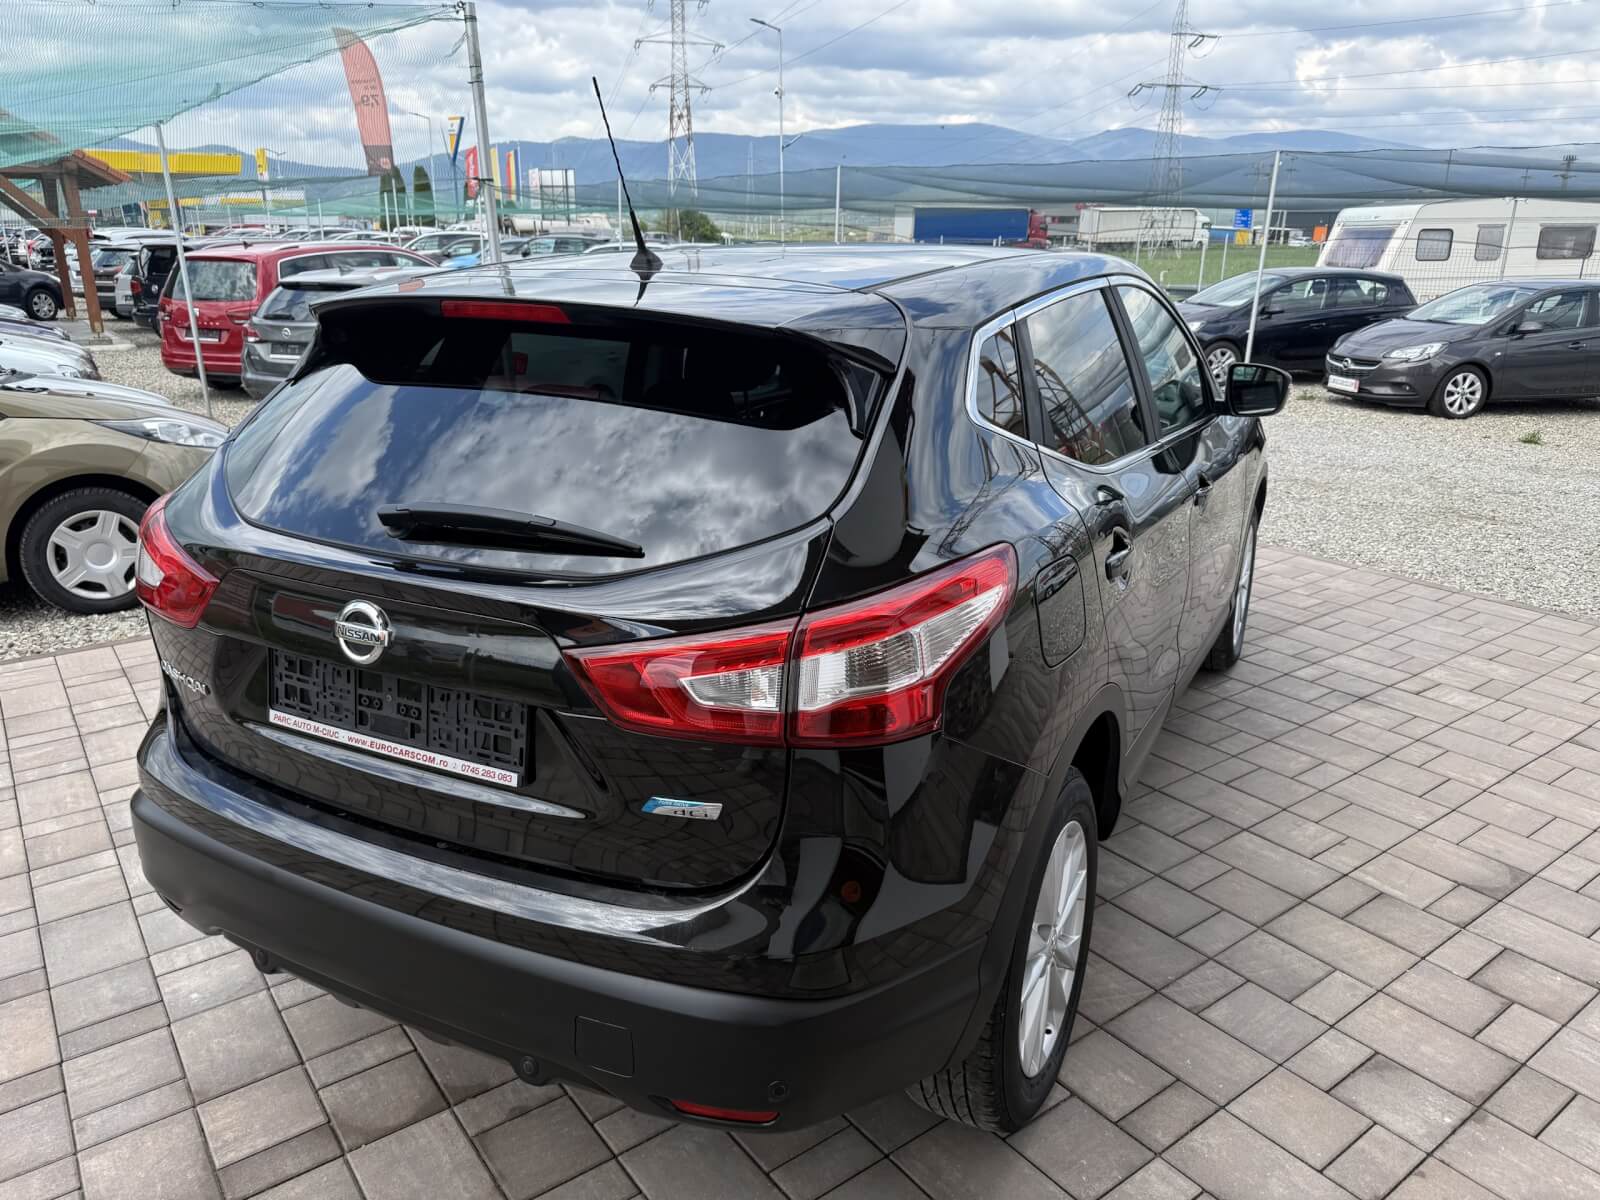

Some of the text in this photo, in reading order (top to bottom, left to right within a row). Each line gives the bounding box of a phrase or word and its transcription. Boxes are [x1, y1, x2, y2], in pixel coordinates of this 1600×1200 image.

[337, 624, 380, 643] NISSAN
[273, 713, 292, 725] PARC
[292, 719, 312, 731] AUTO
[312, 723, 340, 739] M-CIUC
[461, 764, 480, 775] 0745
[481, 768, 496, 778] 283
[497, 772, 513, 783] 083
